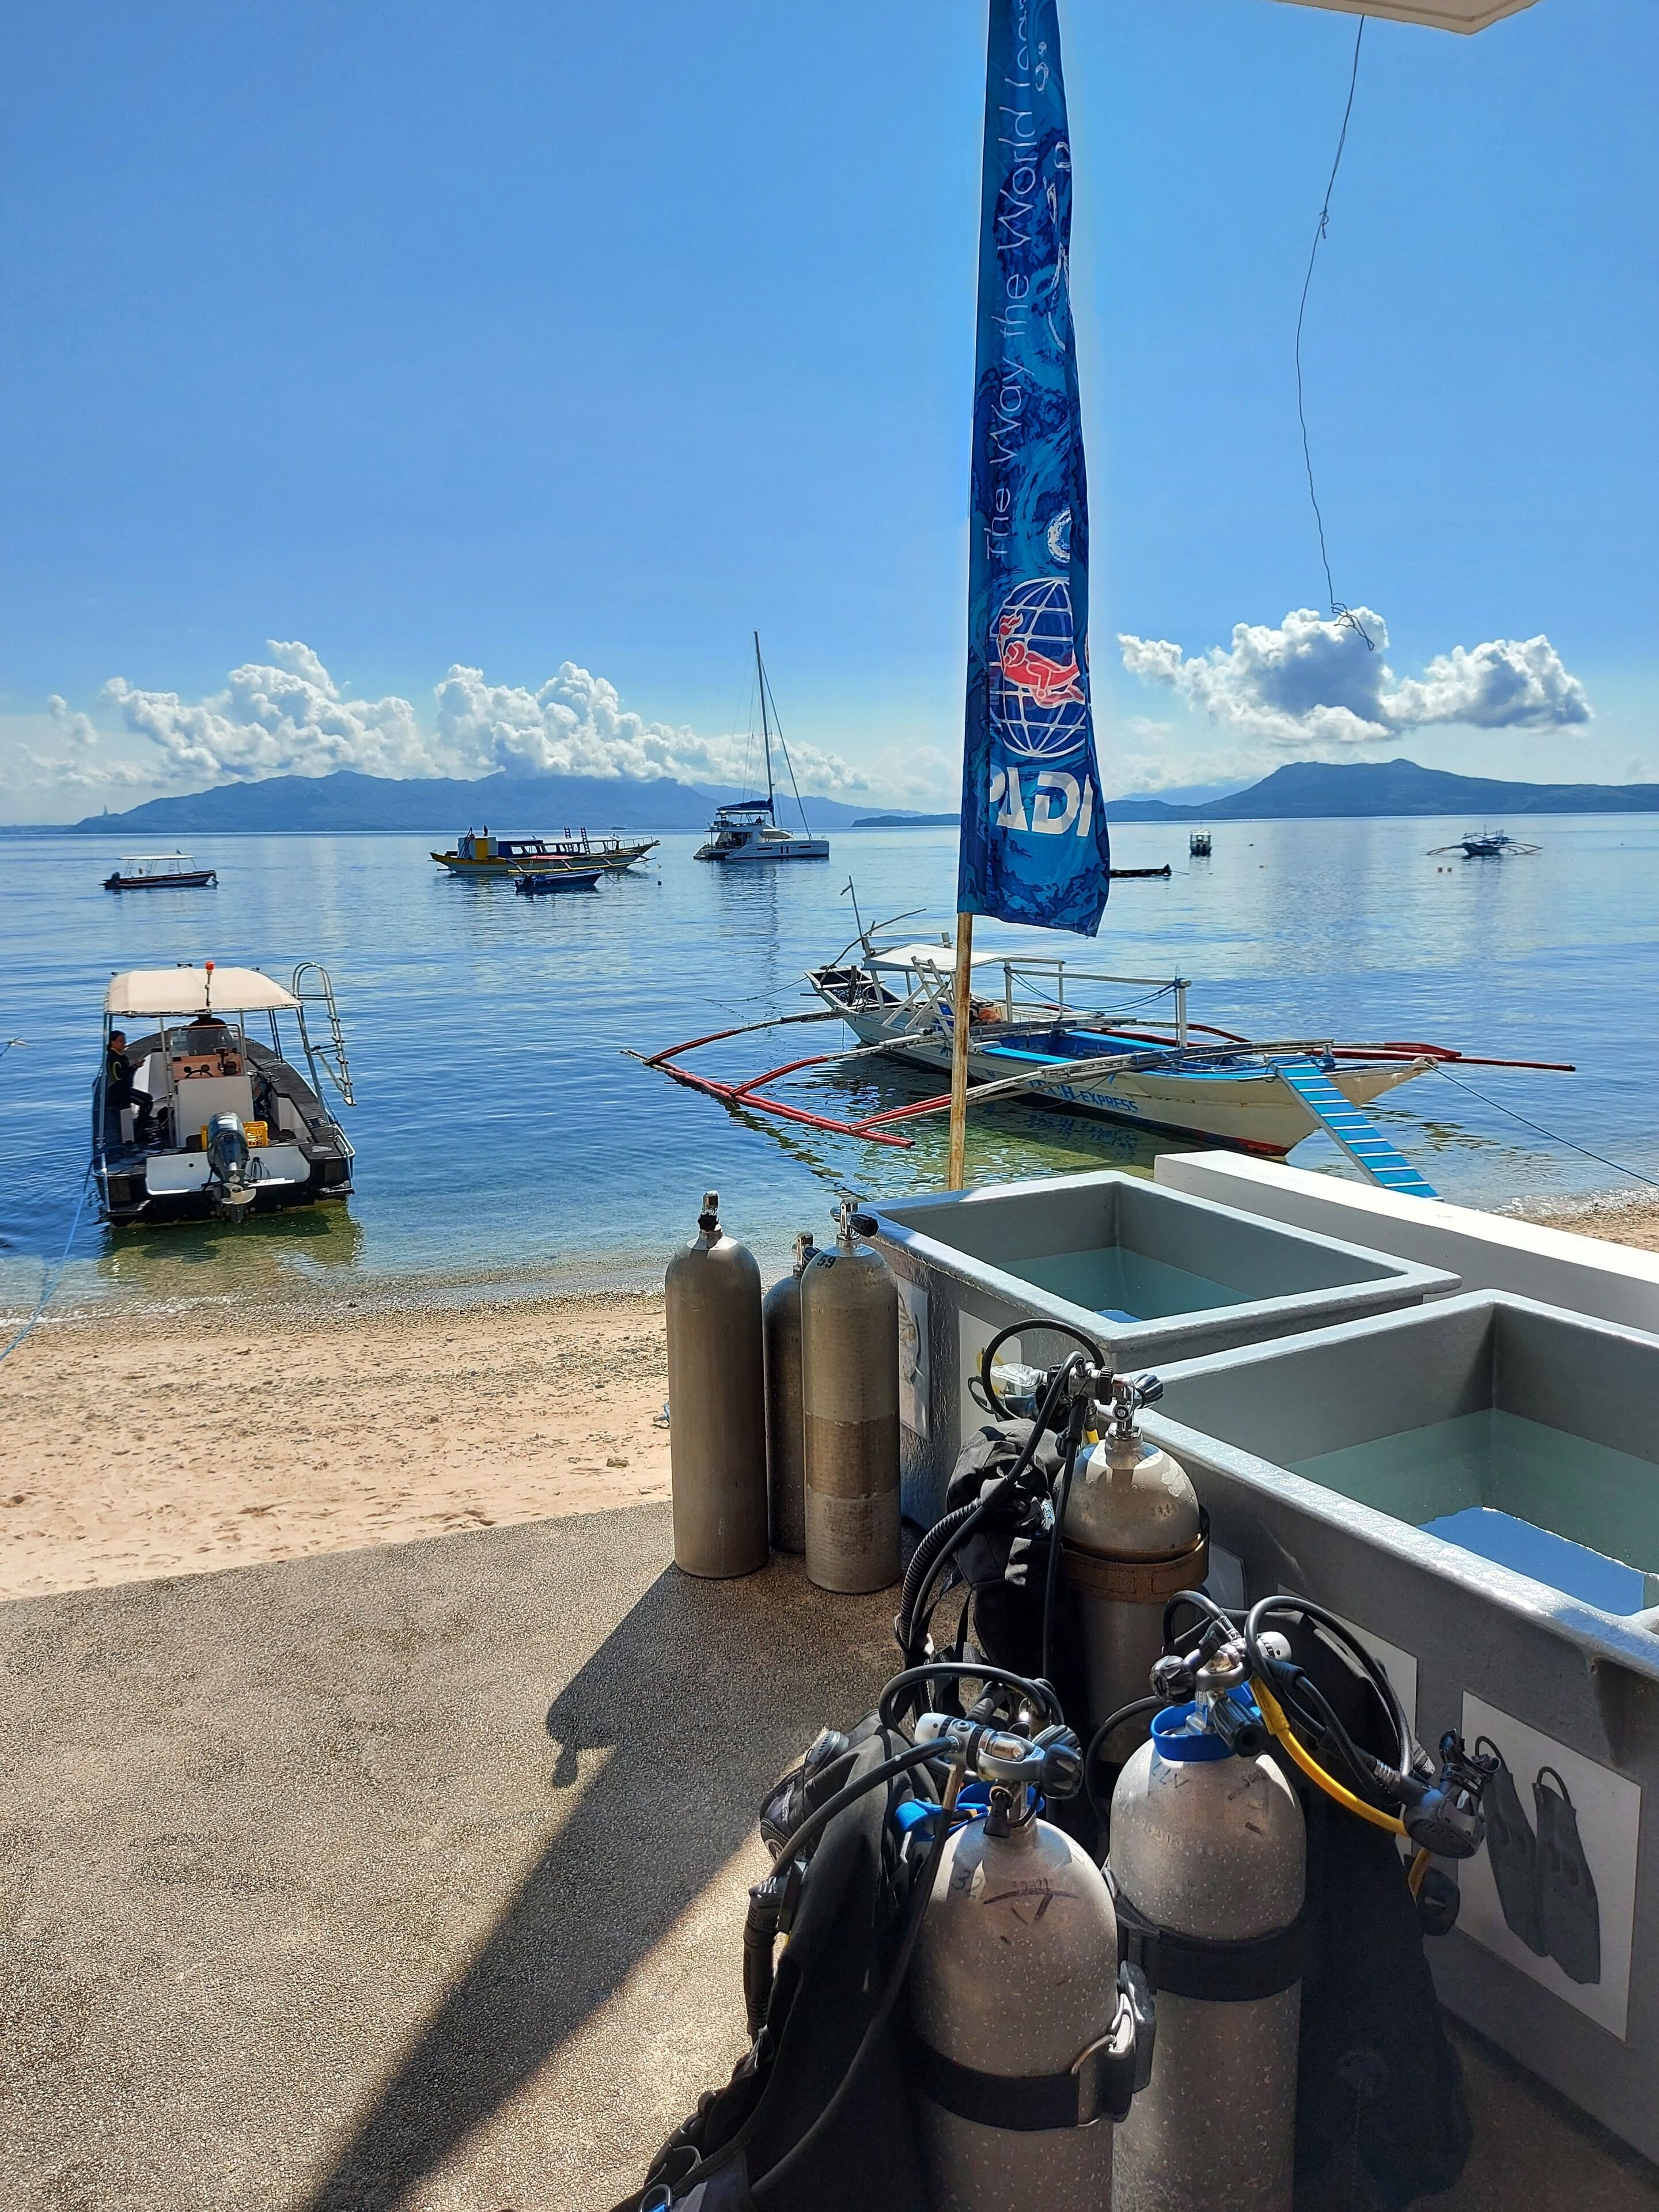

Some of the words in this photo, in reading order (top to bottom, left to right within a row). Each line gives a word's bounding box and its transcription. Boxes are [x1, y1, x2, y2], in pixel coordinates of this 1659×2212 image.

[997, 106, 1037, 251] World
[990, 273, 1030, 338] the
[989, 355, 1035, 464] Way
[983, 487, 1011, 560] The
[1081, 1090, 1139, 1112] EXPRESS
